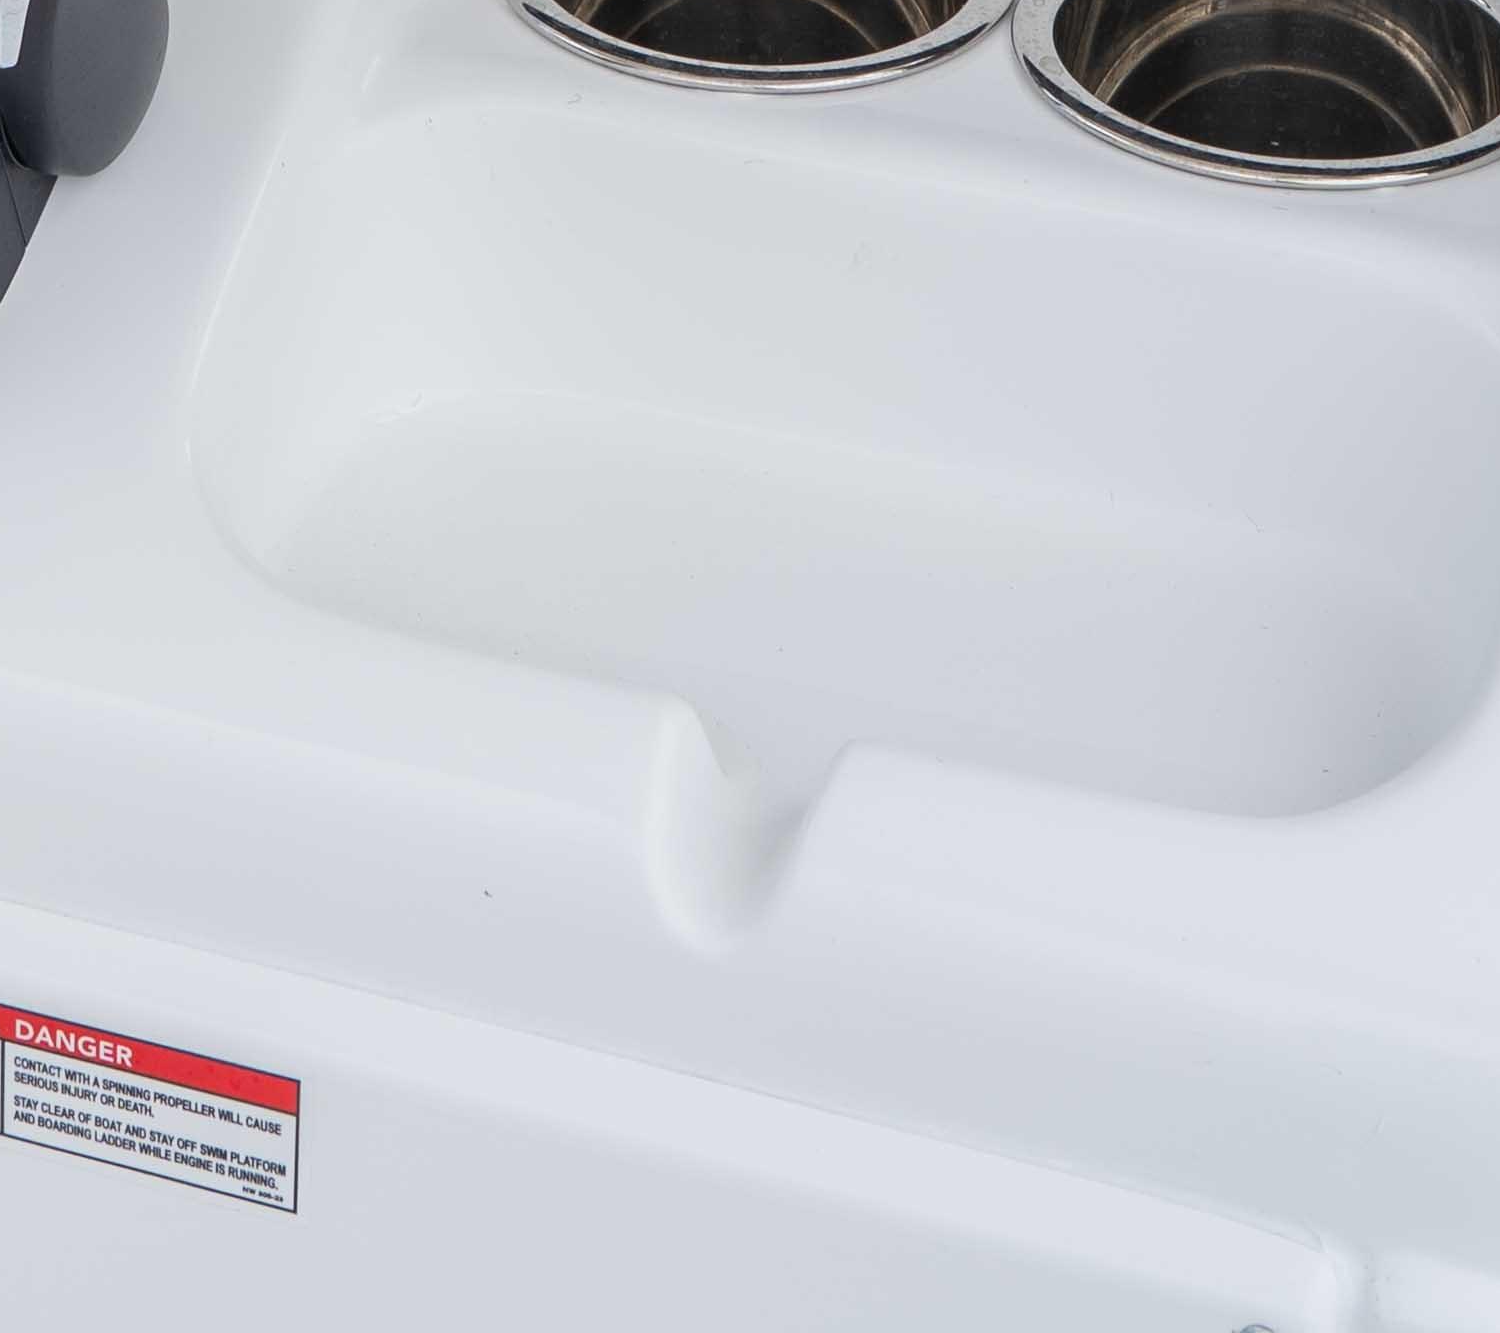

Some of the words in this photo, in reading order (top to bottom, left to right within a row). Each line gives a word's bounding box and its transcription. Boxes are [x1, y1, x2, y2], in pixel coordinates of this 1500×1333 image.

[15, 1018, 133, 1068] DANGER
[14, 1056, 61, 1079] CONTACT
[64, 1068, 90, 1086] WITH
[92, 1075, 100, 1088] A
[102, 1078, 151, 1101] SPINNING
[153, 1092, 216, 1119] PROPELLER
[218, 1107, 243, 1126] WILL
[246, 1115, 282, 1136] CAUSE
